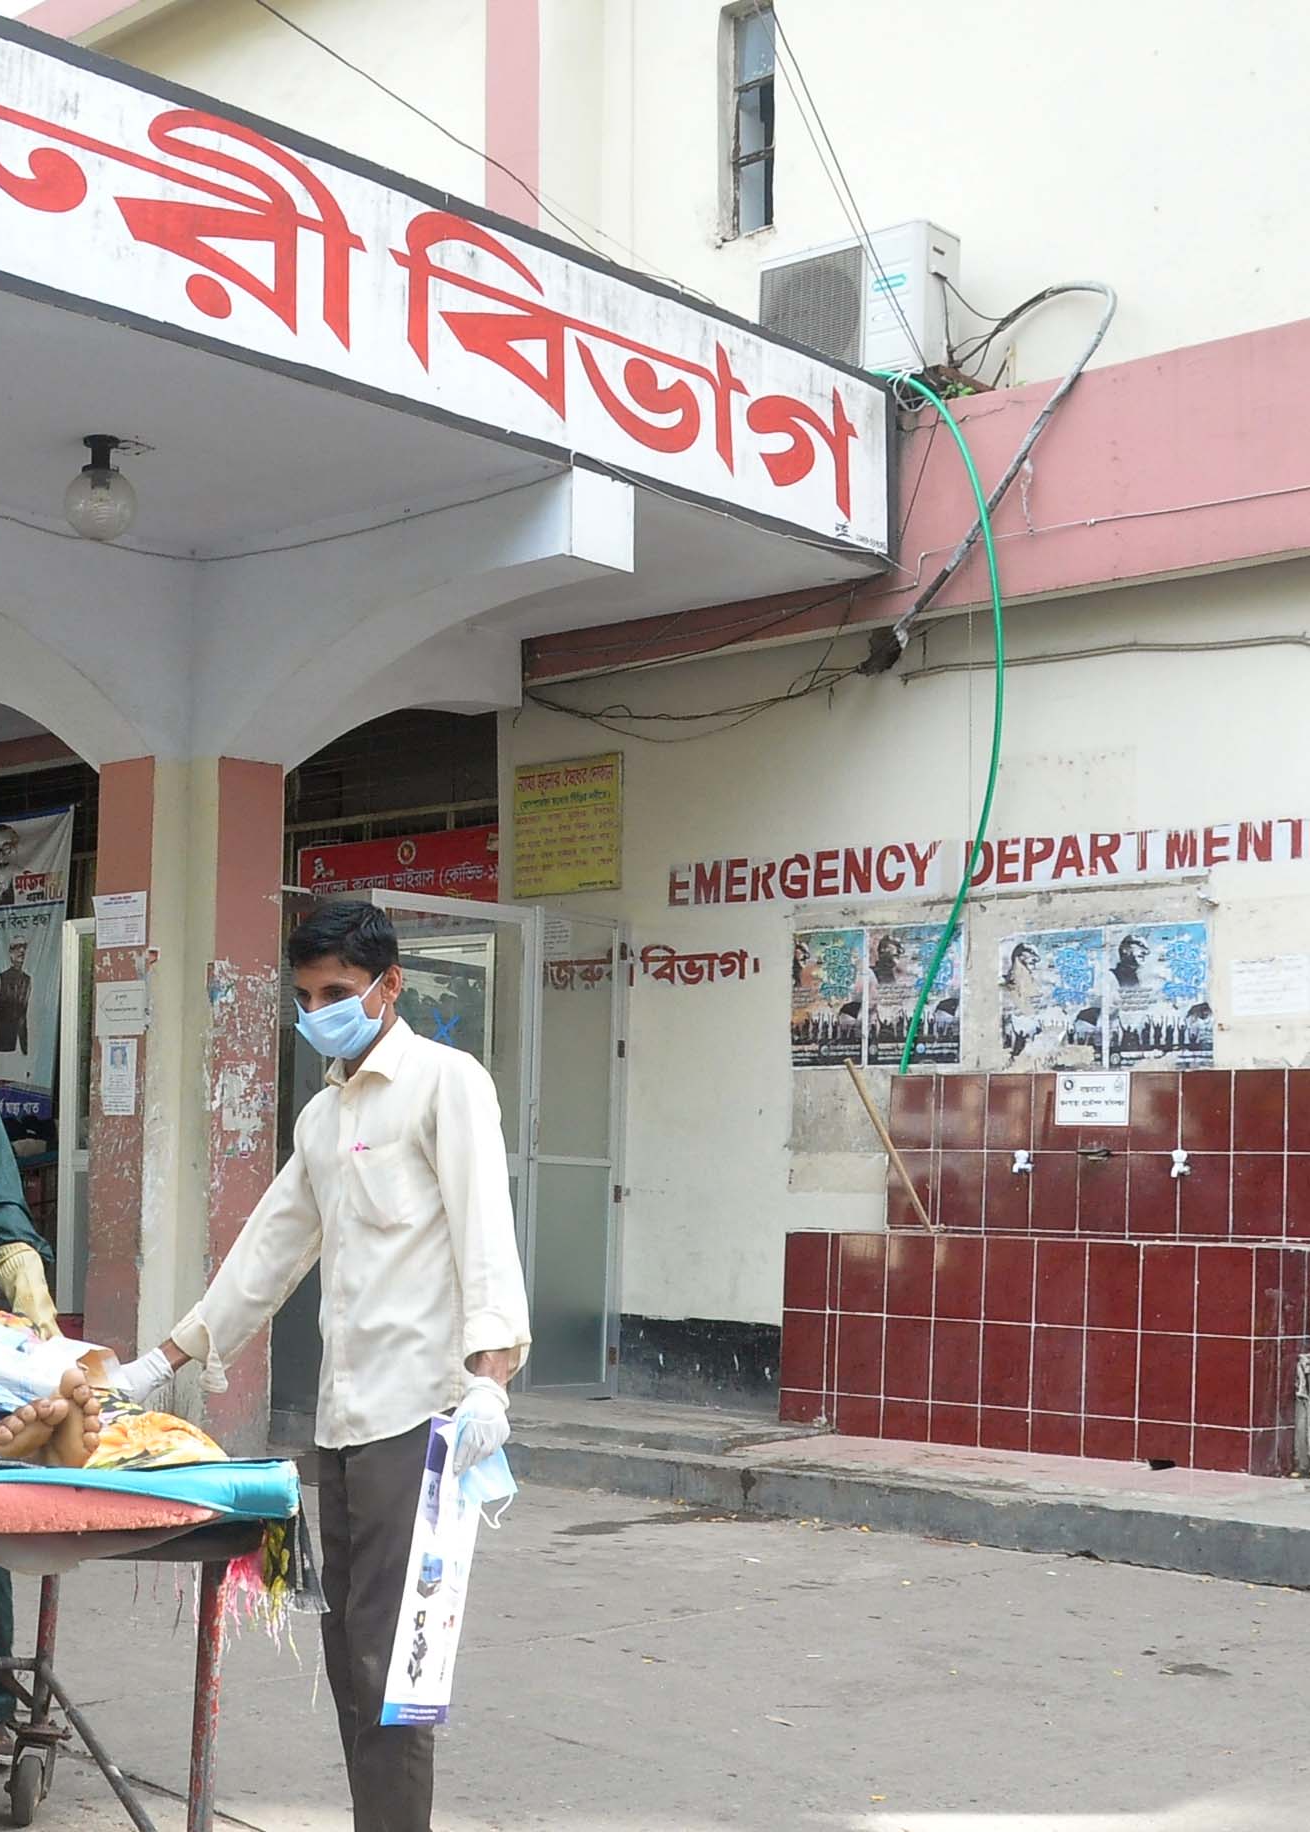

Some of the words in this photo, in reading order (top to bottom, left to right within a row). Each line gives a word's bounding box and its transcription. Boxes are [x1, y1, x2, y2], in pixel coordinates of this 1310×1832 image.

[389, 210, 860, 523] বিভাগ
[668, 839, 942, 907] EMERGENCY
[963, 818, 1304, 888] DEPARTMENT
